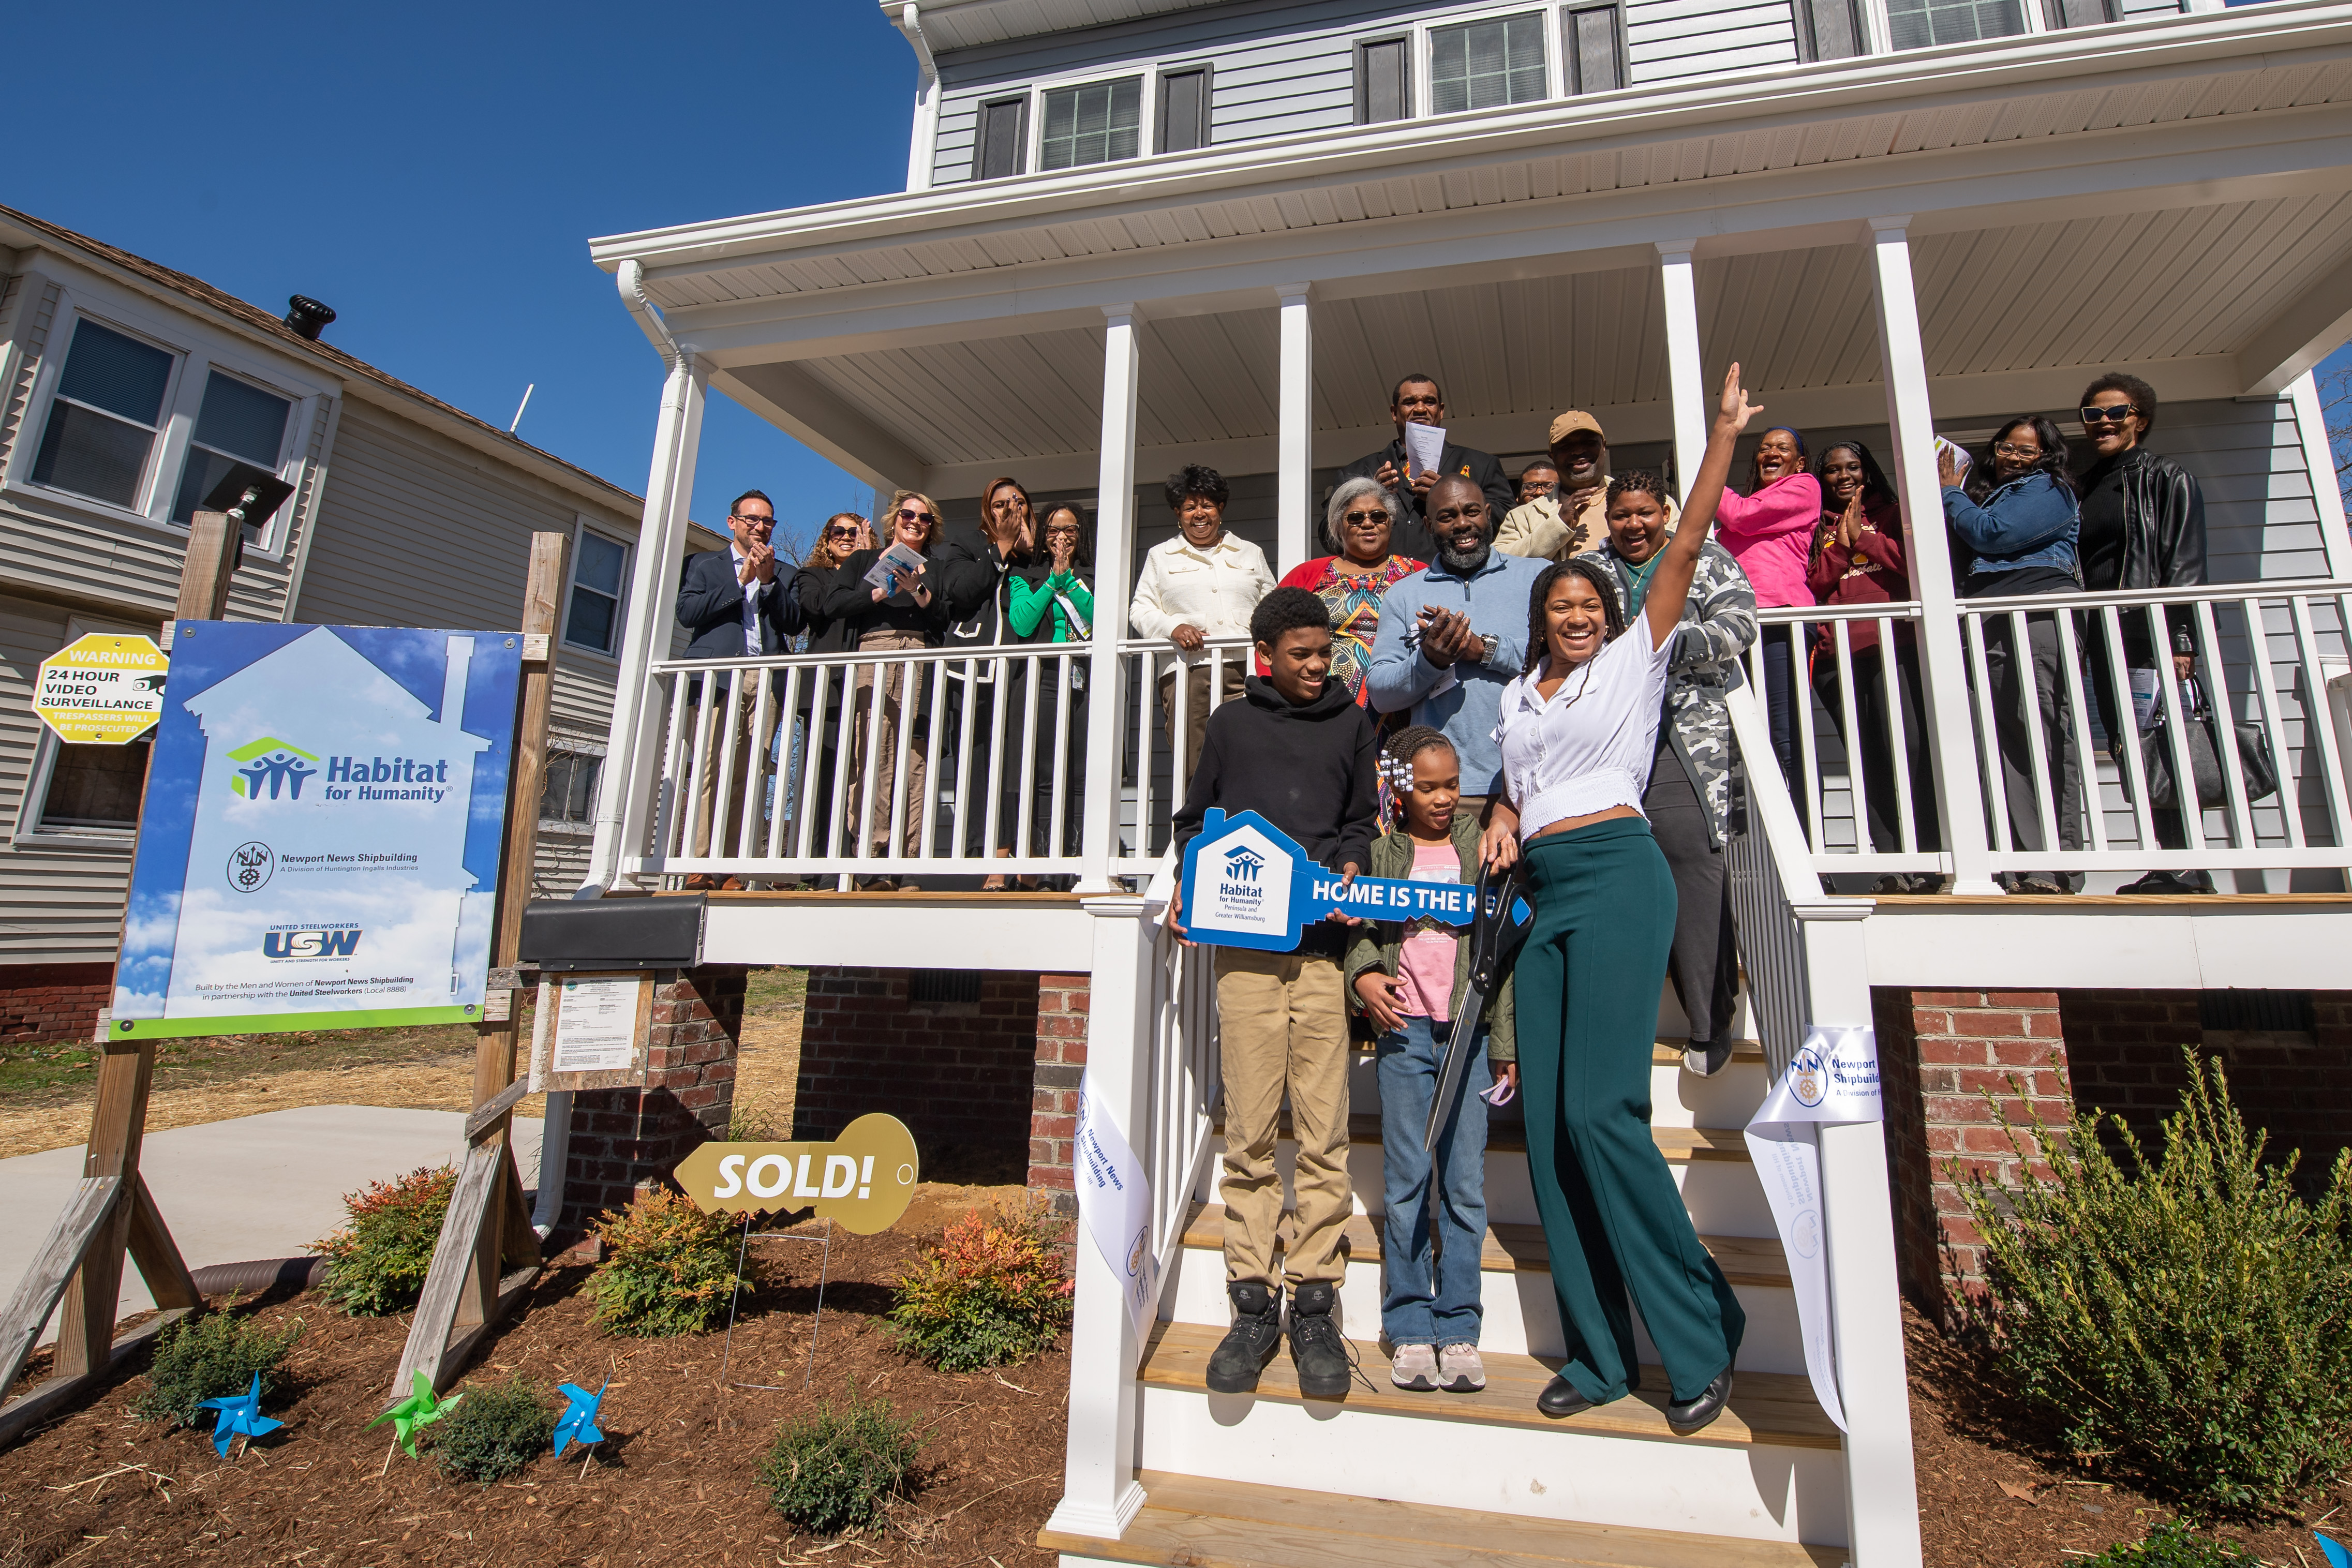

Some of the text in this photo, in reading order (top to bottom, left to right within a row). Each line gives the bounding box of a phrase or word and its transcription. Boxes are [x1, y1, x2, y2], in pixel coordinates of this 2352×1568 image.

[69, 650, 156, 665] WARNING
[47, 669, 120, 682] 24 HOUR
[46, 684, 97, 695] VIDEO
[41, 697, 153, 709] SURVEILLANCE
[53, 712, 122, 721] TRESPASSERS
[75, 724, 138, 733] PROSECUTED
[327, 756, 448, 783] Habitat
[325, 785, 352, 800] for
[281, 853, 418, 864] Newport News Shipbuilding
[1220, 883, 1262, 898] Habitat
[1313, 880, 1384, 905] HOME
[1390, 886, 1410, 907] IS
[1415, 888, 1461, 912] THE
[1231, 897, 1261, 906] Humanity
[1234, 913, 1265, 923] Williamsburg
[263, 930, 363, 958] USW
[370, 976, 413, 985] Shipbuilding
[211, 992, 256, 1001] partnership
[1833, 1059, 1875, 1070] Newport
[1080, 1135, 1106, 1188] Shipbuilding
[1087, 1129, 1123, 1191] Newport News
[714, 1154, 874, 1199] SOLD!
